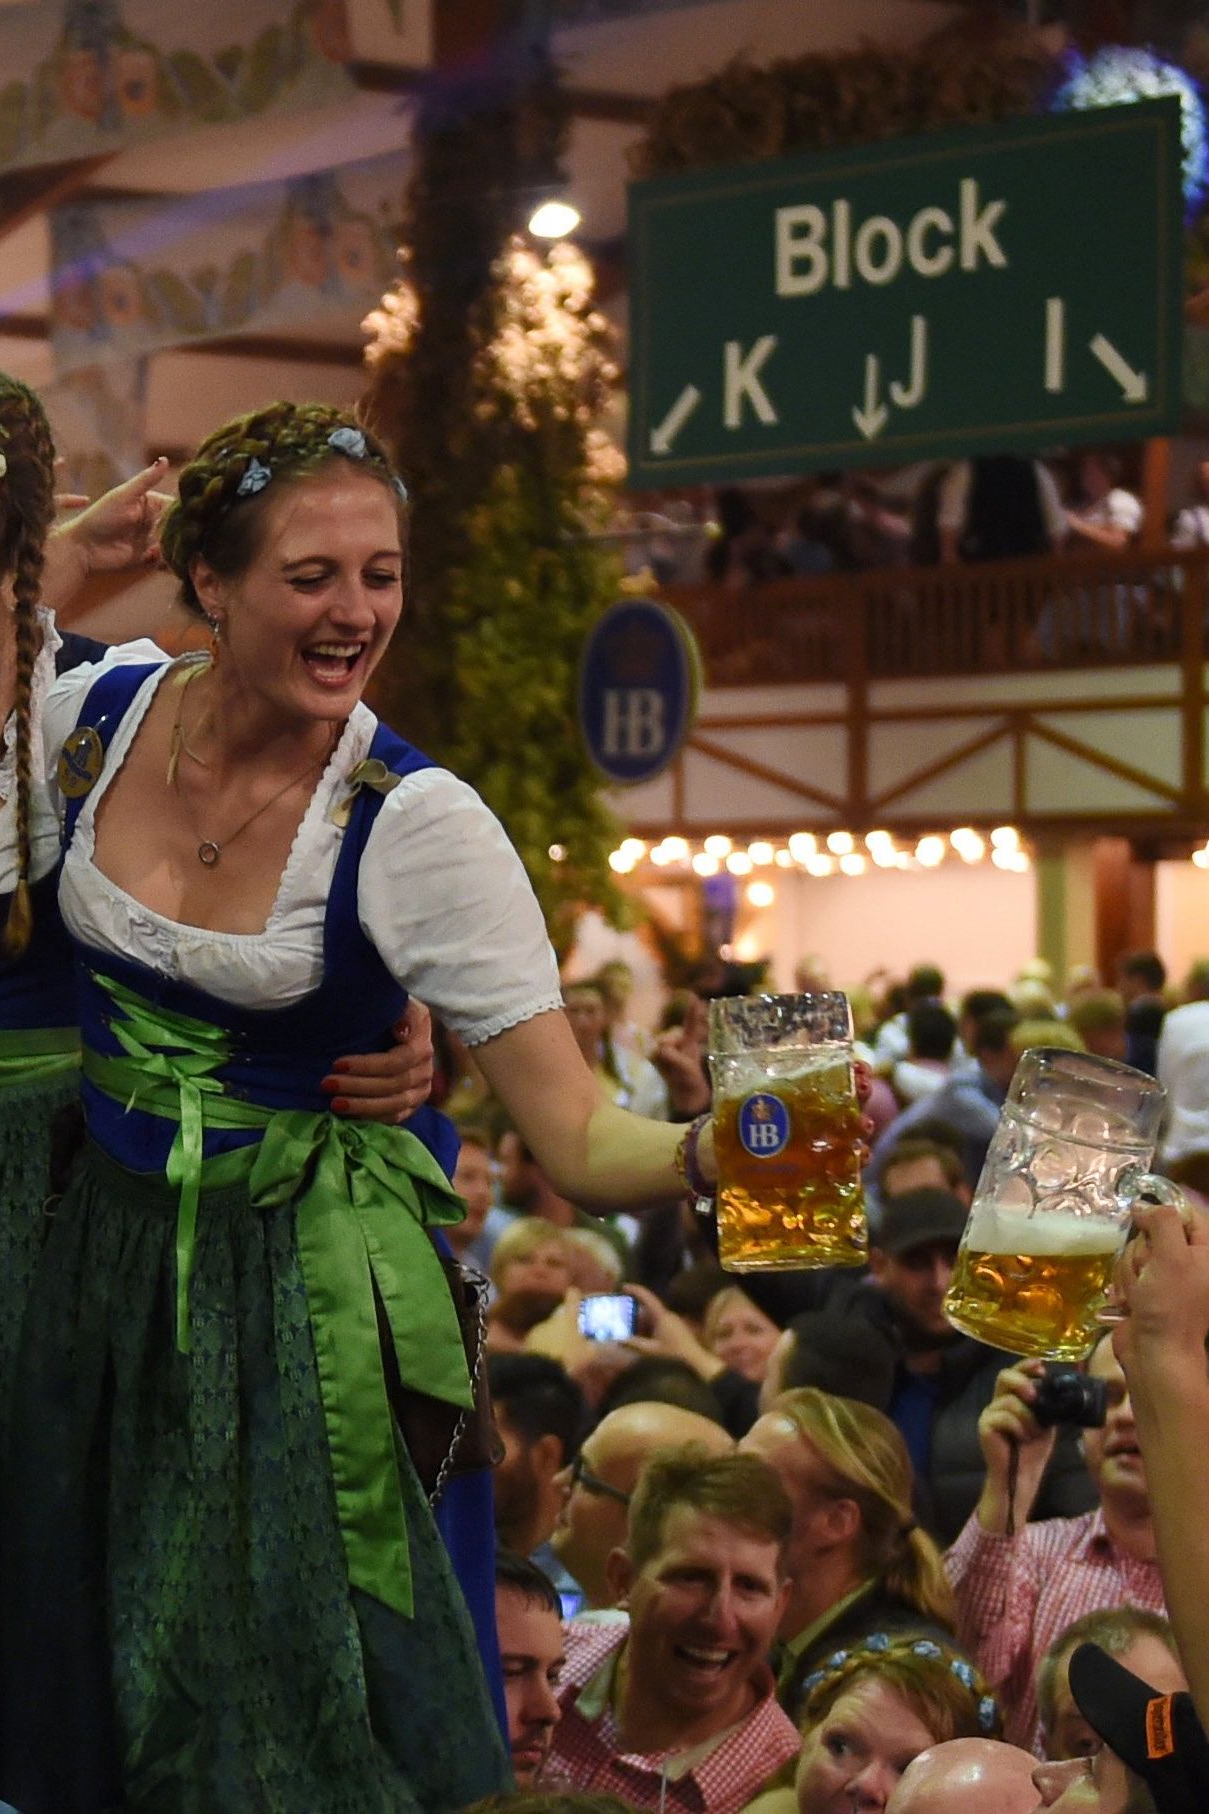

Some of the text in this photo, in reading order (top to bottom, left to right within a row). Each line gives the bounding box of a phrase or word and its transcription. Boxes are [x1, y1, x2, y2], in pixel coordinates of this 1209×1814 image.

[775, 176, 1007, 298] Block
[723, 334, 778, 430] K
[889, 314, 927, 409] J
[603, 687, 666, 756] HB
[749, 1123, 780, 1148] HB
